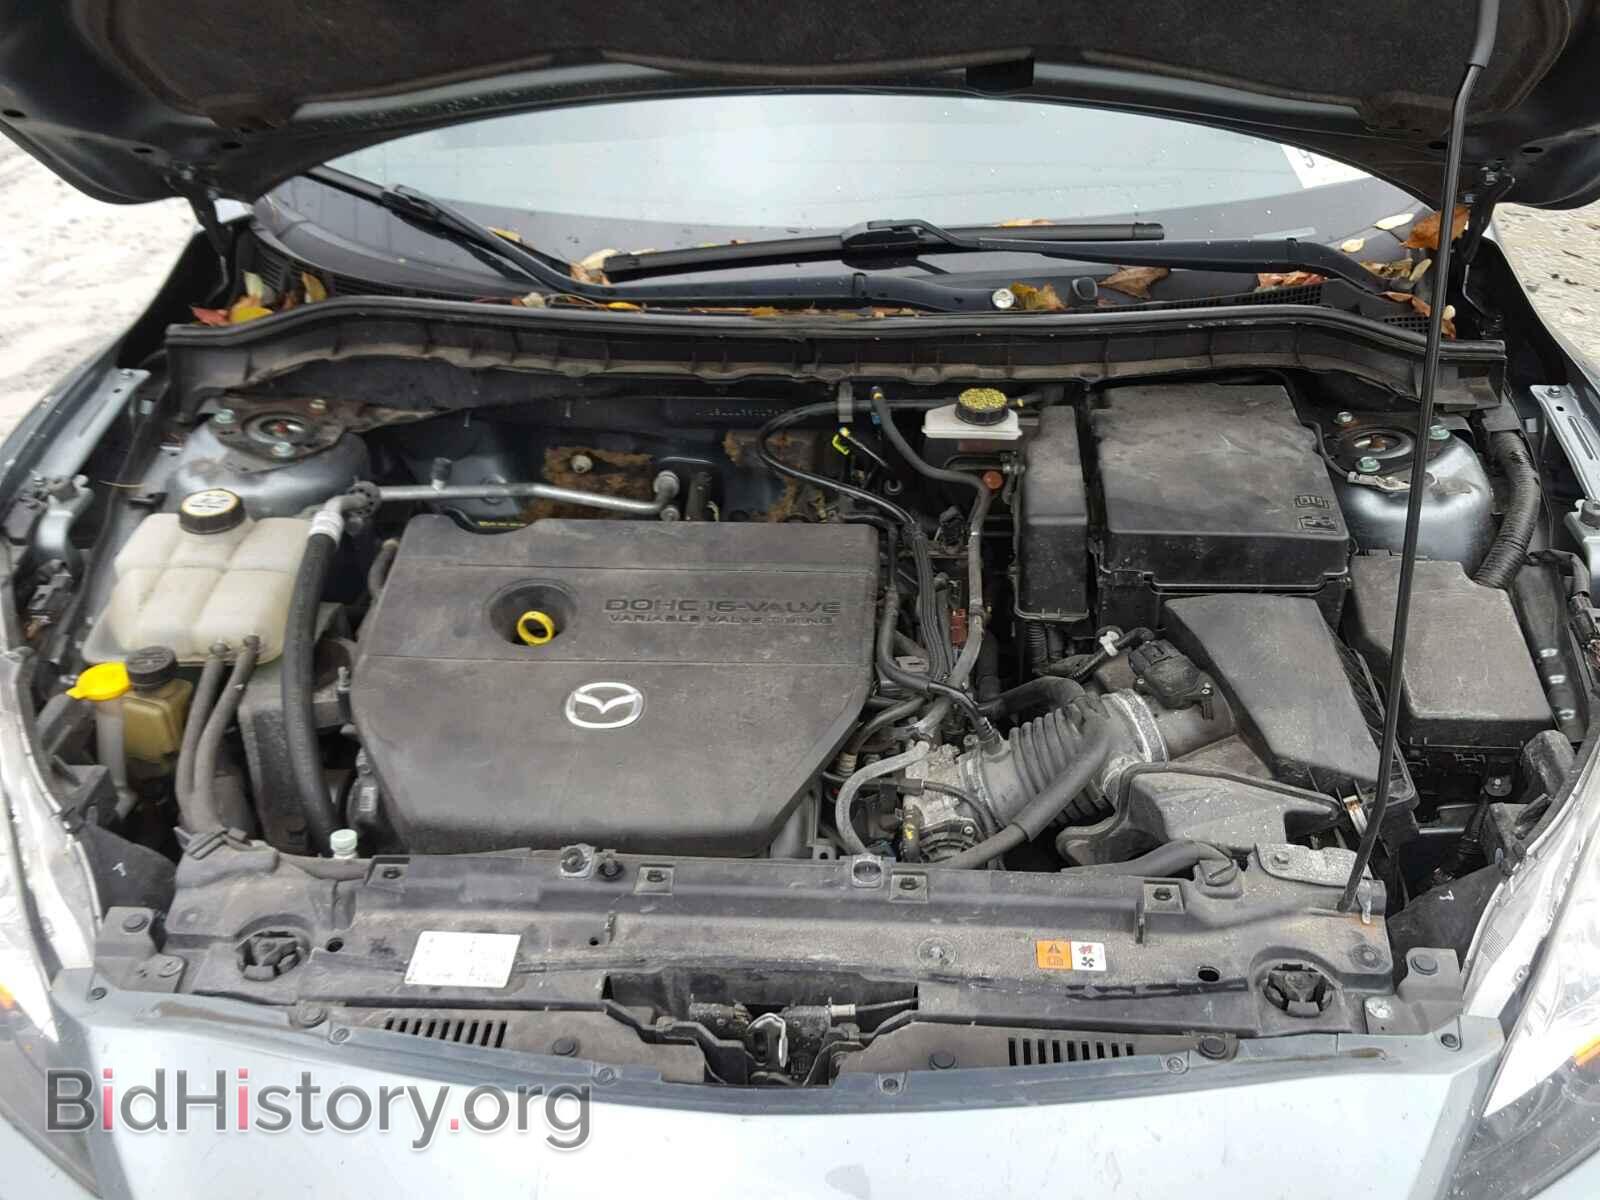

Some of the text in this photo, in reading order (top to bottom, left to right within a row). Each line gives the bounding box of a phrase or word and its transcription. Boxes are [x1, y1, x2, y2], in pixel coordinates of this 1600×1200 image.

[605, 598, 841, 614] DOHC 16-VALVE
[609, 614, 700, 623] VARIABLE
[707, 615, 762, 624] VALVE
